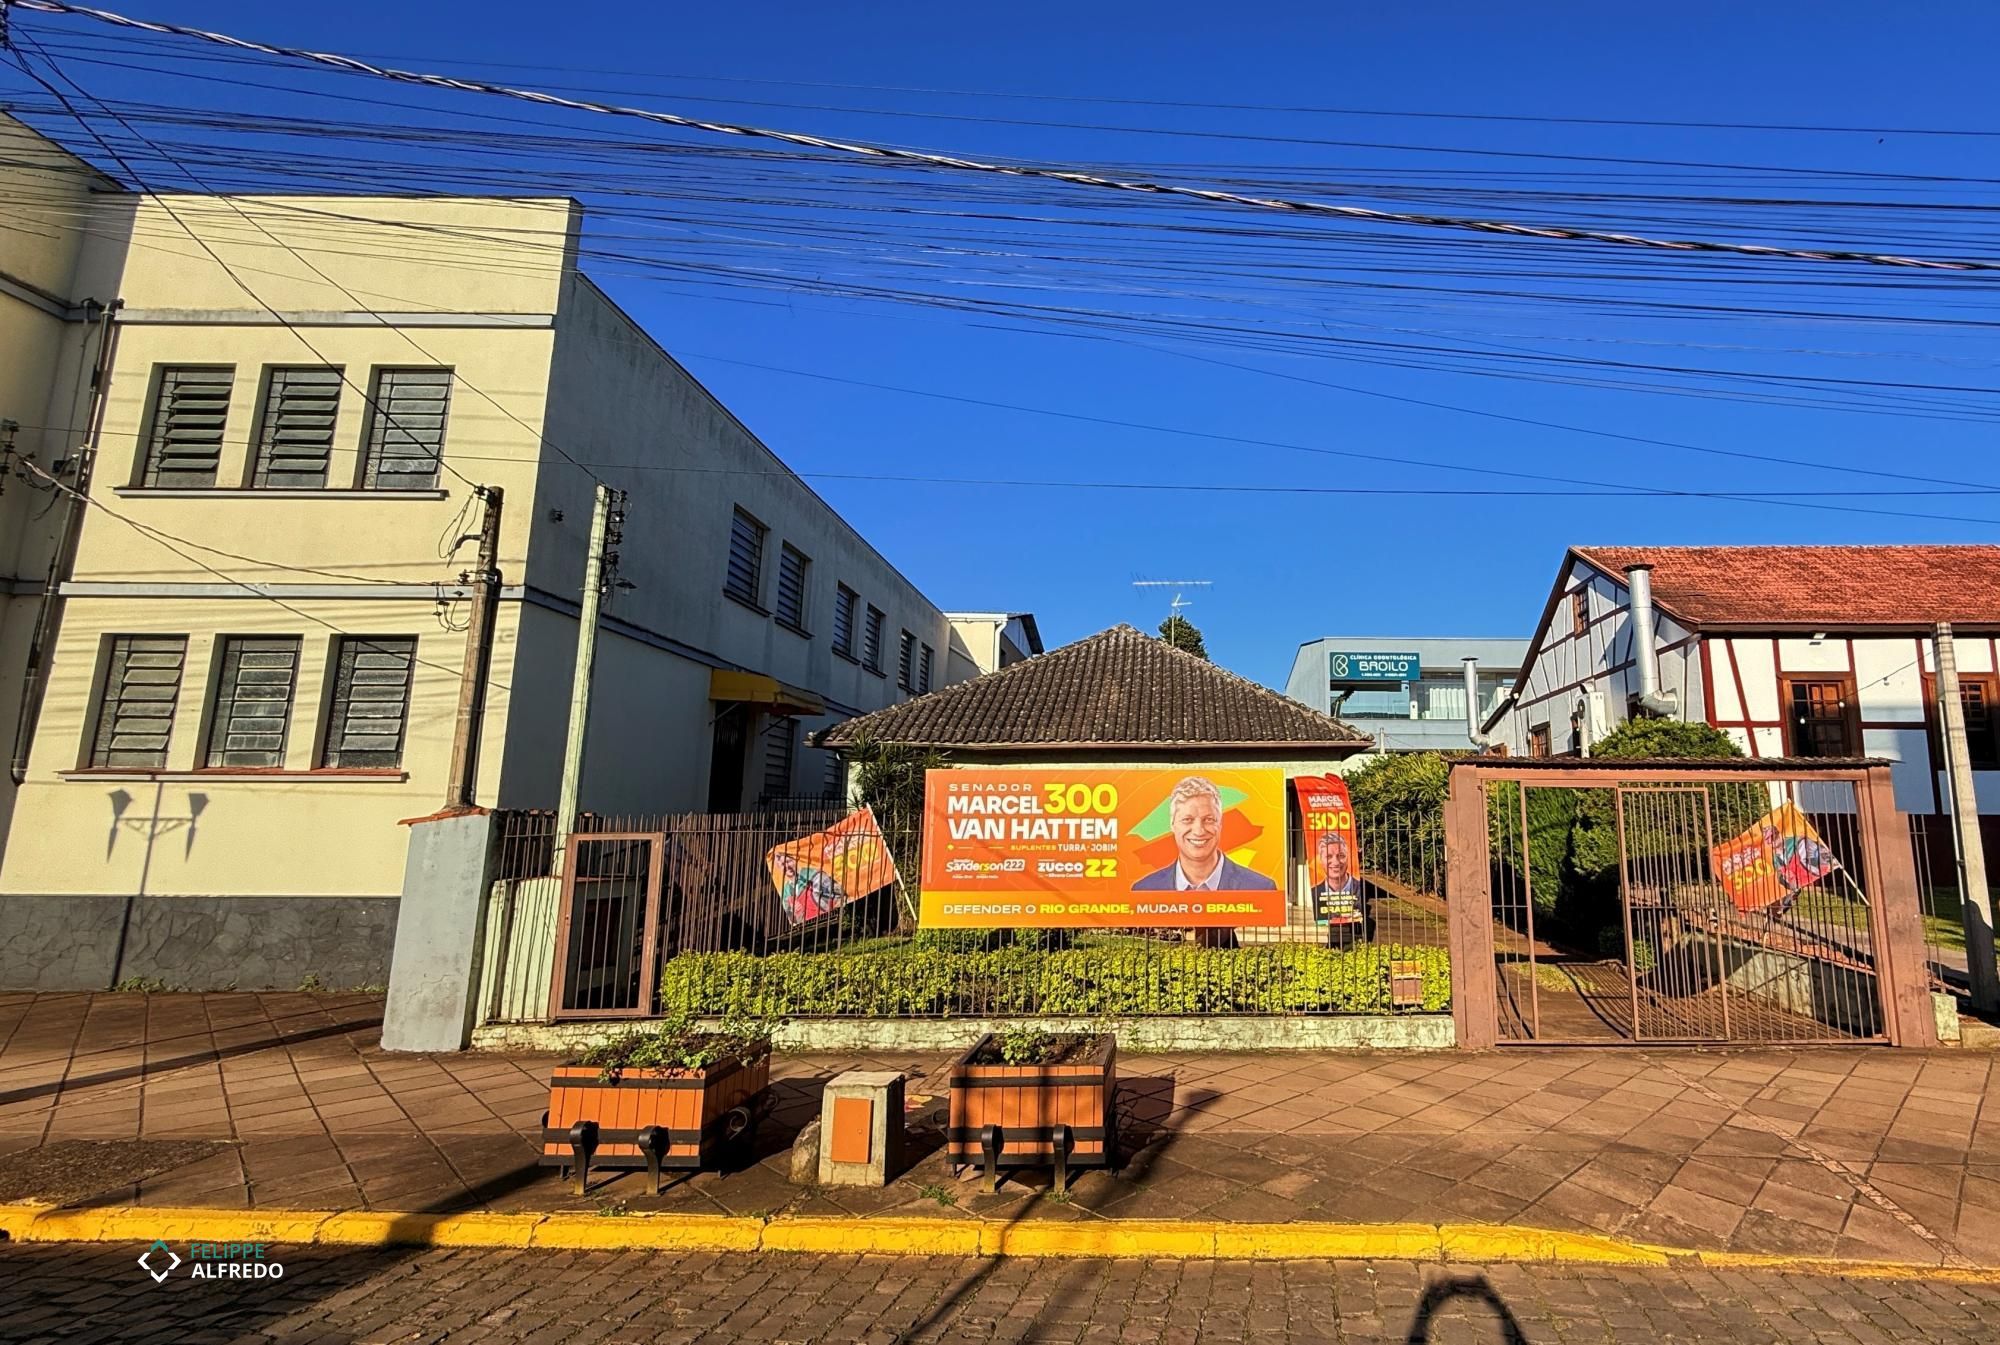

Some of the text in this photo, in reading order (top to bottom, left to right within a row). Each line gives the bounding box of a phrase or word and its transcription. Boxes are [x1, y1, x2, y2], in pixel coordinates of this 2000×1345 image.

[1359, 661, 1408, 671] BROILO
[948, 784, 1033, 792] SENADOR
[948, 783, 1118, 814] MARCEL 300
[1307, 811, 1351, 830] 300
[948, 818, 1118, 839] VAN HATTEM
[1058, 843, 1086, 851] TURRA
[1091, 843, 1117, 851] JOBIM
[945, 860, 1023, 872] Sanderson 222
[1085, 858, 1118, 877] 22
[943, 903, 1263, 915] DEFENDER O RIO GRANDE, MUDAR O BRASIL.
